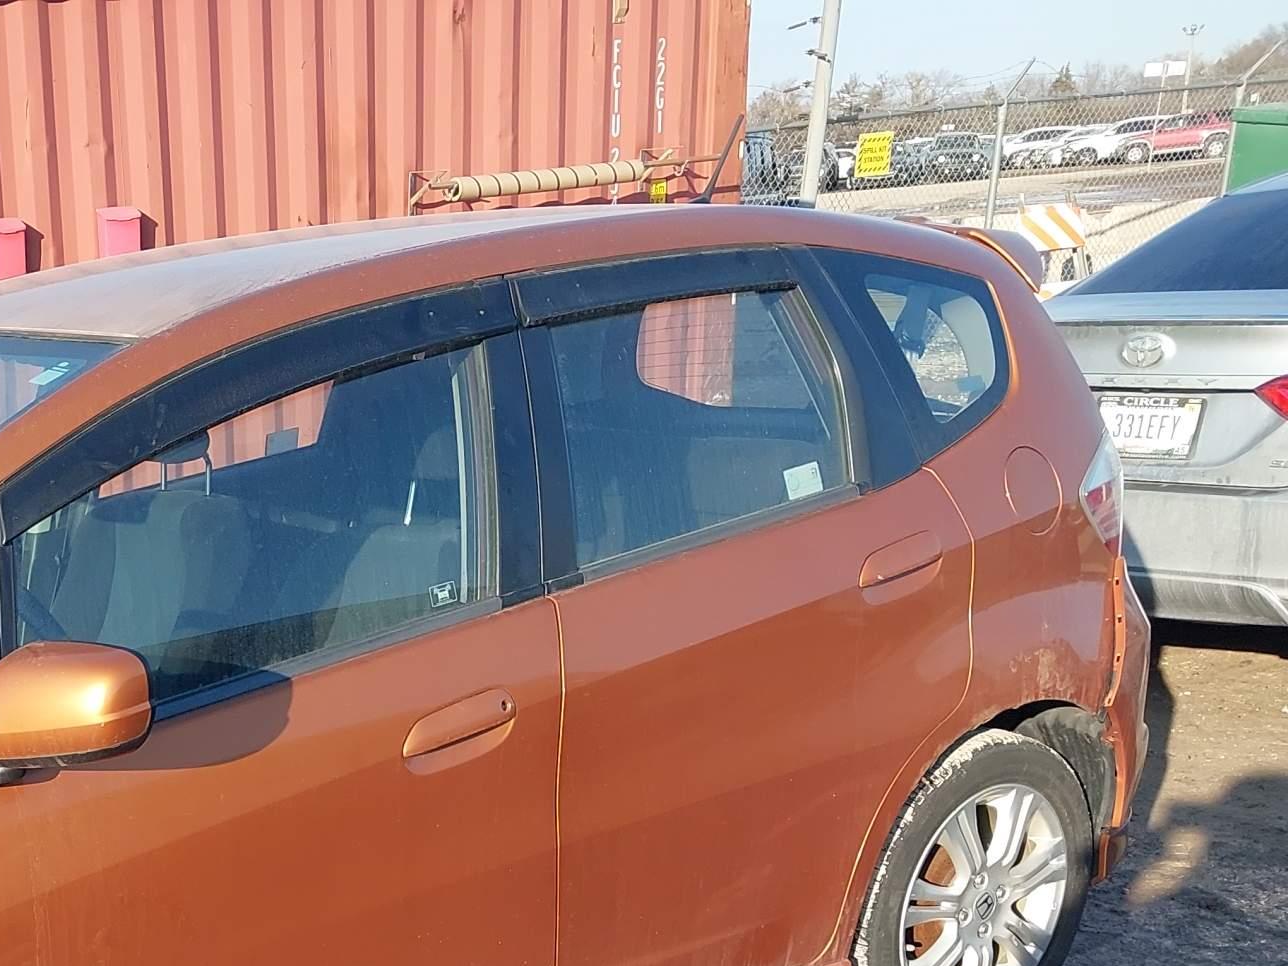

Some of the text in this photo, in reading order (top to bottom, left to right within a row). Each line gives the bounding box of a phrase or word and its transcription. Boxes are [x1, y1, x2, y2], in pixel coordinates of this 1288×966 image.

[610, 39, 622, 138] FCIU
[1123, 396, 1180, 407] CIRCLE
[1112, 413, 1182, 441] 331EFY
